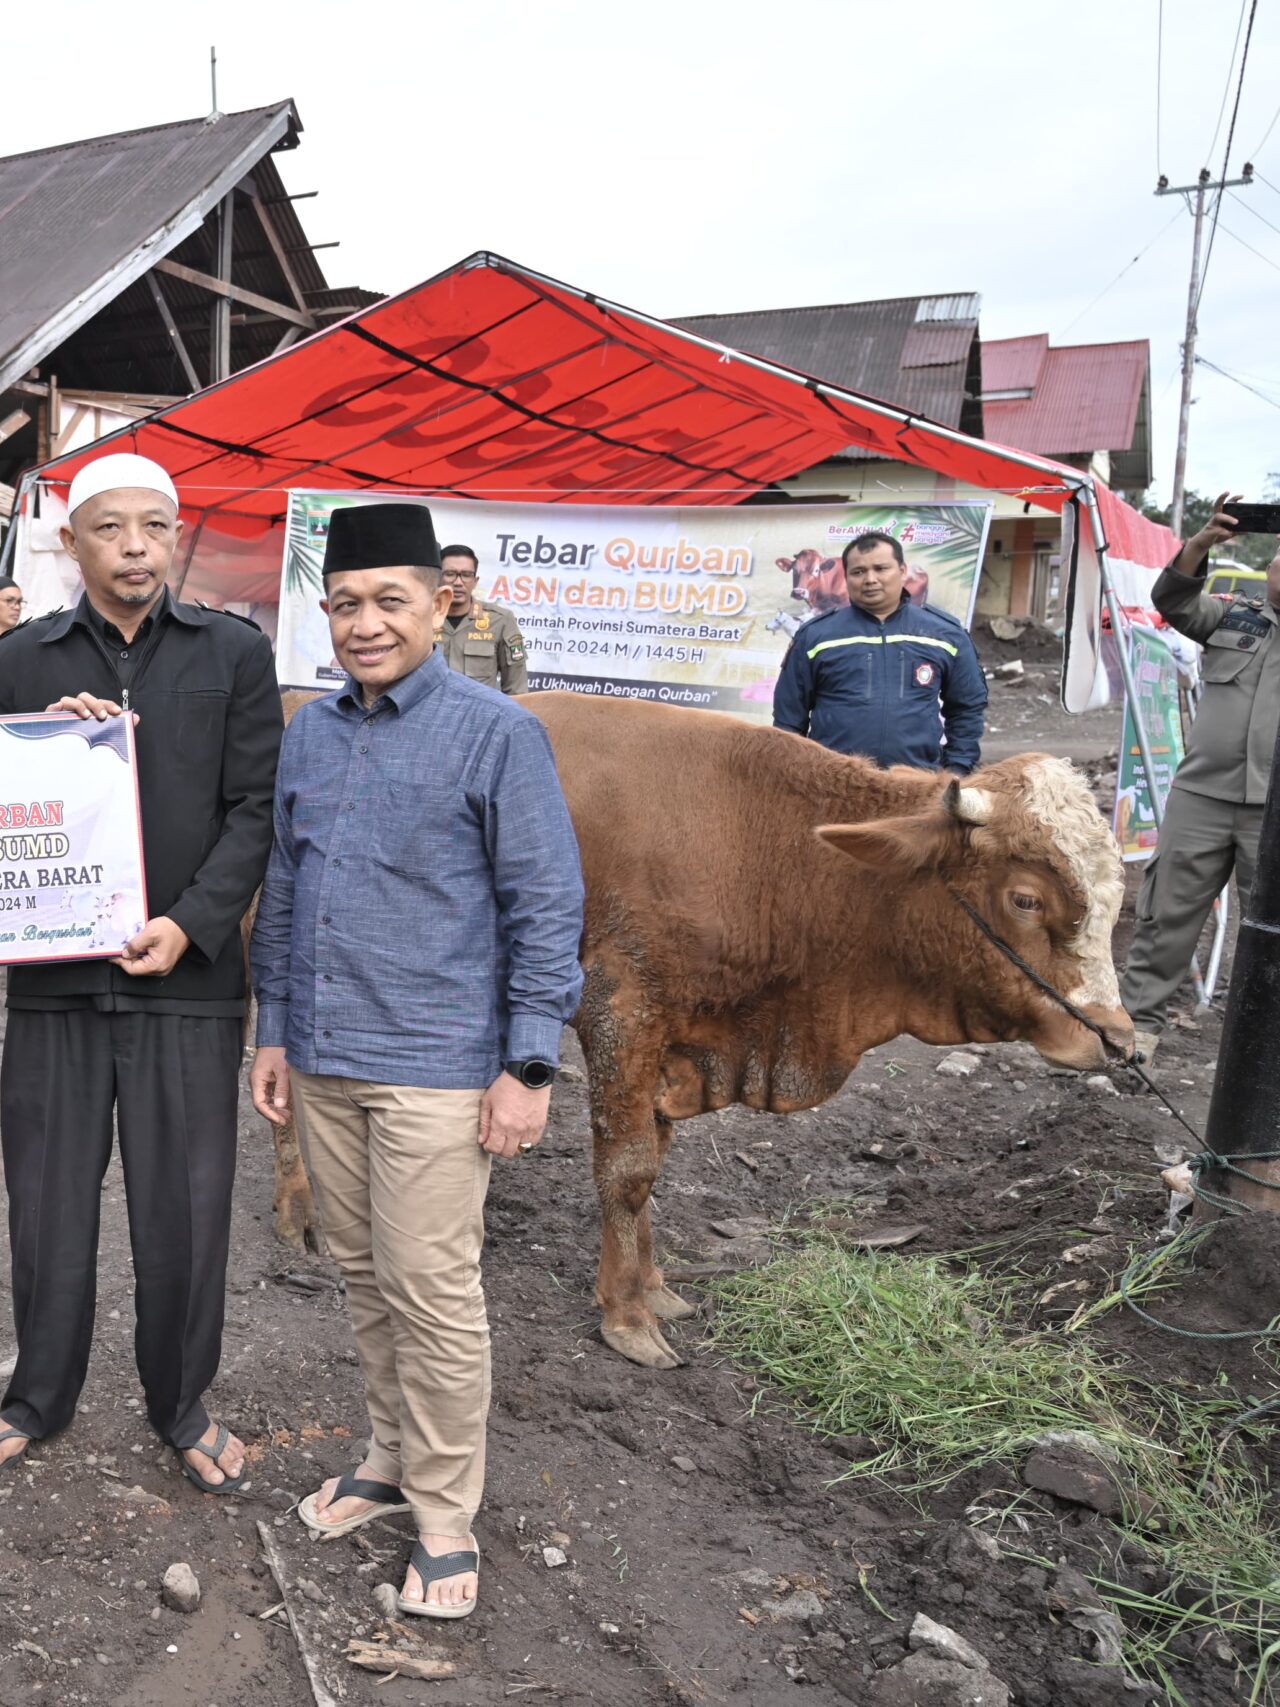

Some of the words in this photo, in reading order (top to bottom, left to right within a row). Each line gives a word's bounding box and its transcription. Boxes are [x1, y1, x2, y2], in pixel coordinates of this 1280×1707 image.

[495, 533, 595, 568] Tebar
[604, 537, 752, 573] Qurban
[488, 575, 558, 604] ASN
[563, 578, 626, 607] dan
[633, 580, 745, 613] BUMD
[468, 632, 482, 640] POL
[516, 616, 565, 629] erintah
[568, 617, 623, 632] Provinsi
[626, 621, 696, 637] Sumatera
[699, 625, 740, 640] Barat
[567, 640, 609, 655] 2024
[614, 643, 628, 656] M
[645, 645, 686, 661] 1445
[690, 648, 704, 662] H
[542, 677, 601, 694] Ukhuwah
[604, 682, 656, 699] Dengan
[37, 864, 104, 888] BARAT
[25, 895, 37, 910] M
